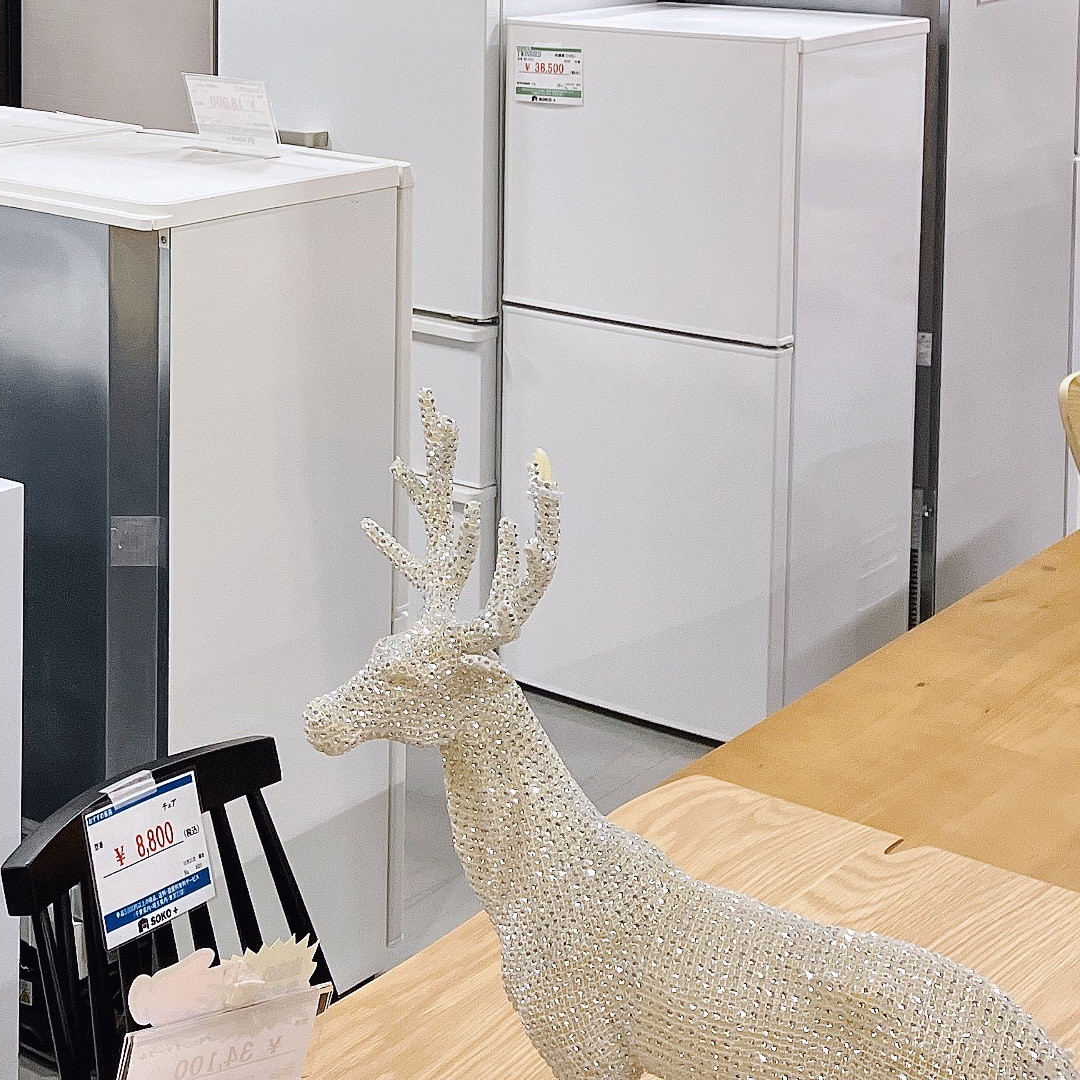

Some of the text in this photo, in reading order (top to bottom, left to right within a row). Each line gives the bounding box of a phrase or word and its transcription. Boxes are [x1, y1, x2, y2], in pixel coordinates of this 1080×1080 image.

[534, 62, 565, 74] 38,500
[113, 845, 126, 867] ¥
[135, 821, 174, 858] 8,800
[150, 908, 172, 926] SOKO
